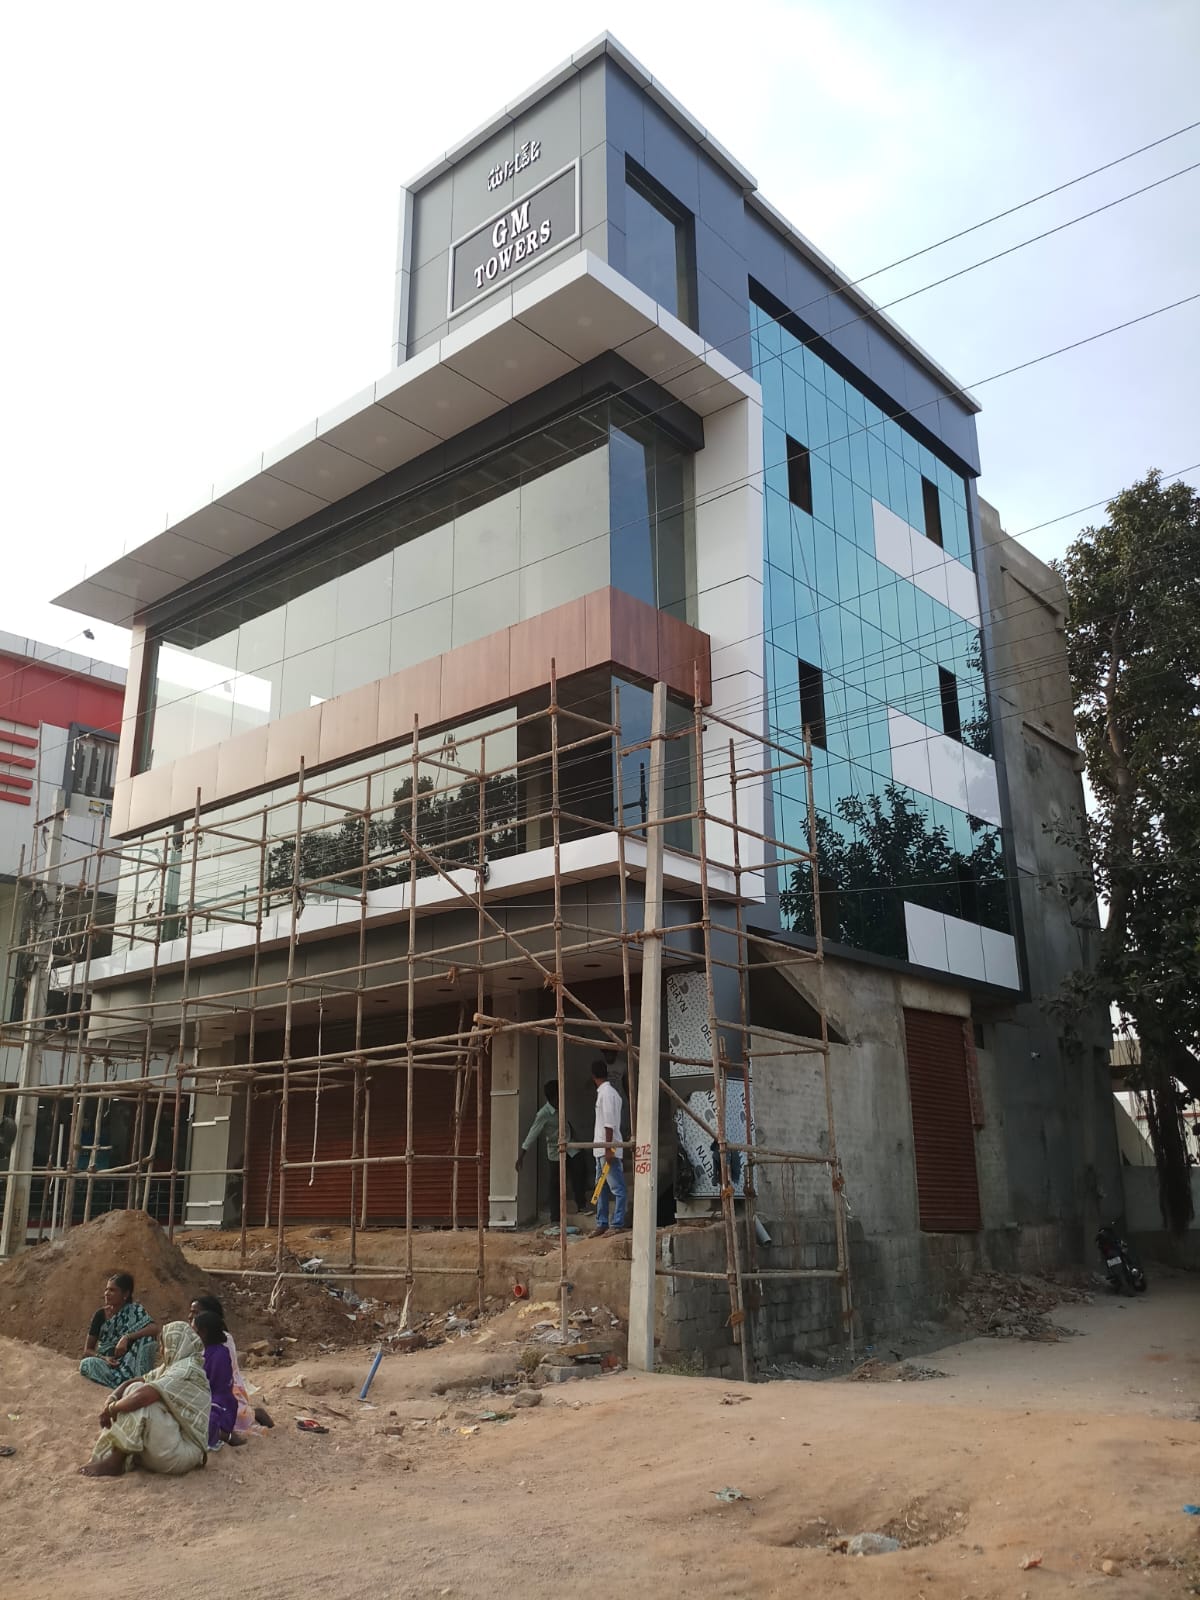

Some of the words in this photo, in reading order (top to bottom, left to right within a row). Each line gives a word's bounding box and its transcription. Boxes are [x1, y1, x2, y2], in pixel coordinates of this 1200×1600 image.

[491, 201, 531, 248] GM
[474, 219, 551, 288] TOWERS
[635, 1144, 651, 1158] 272
